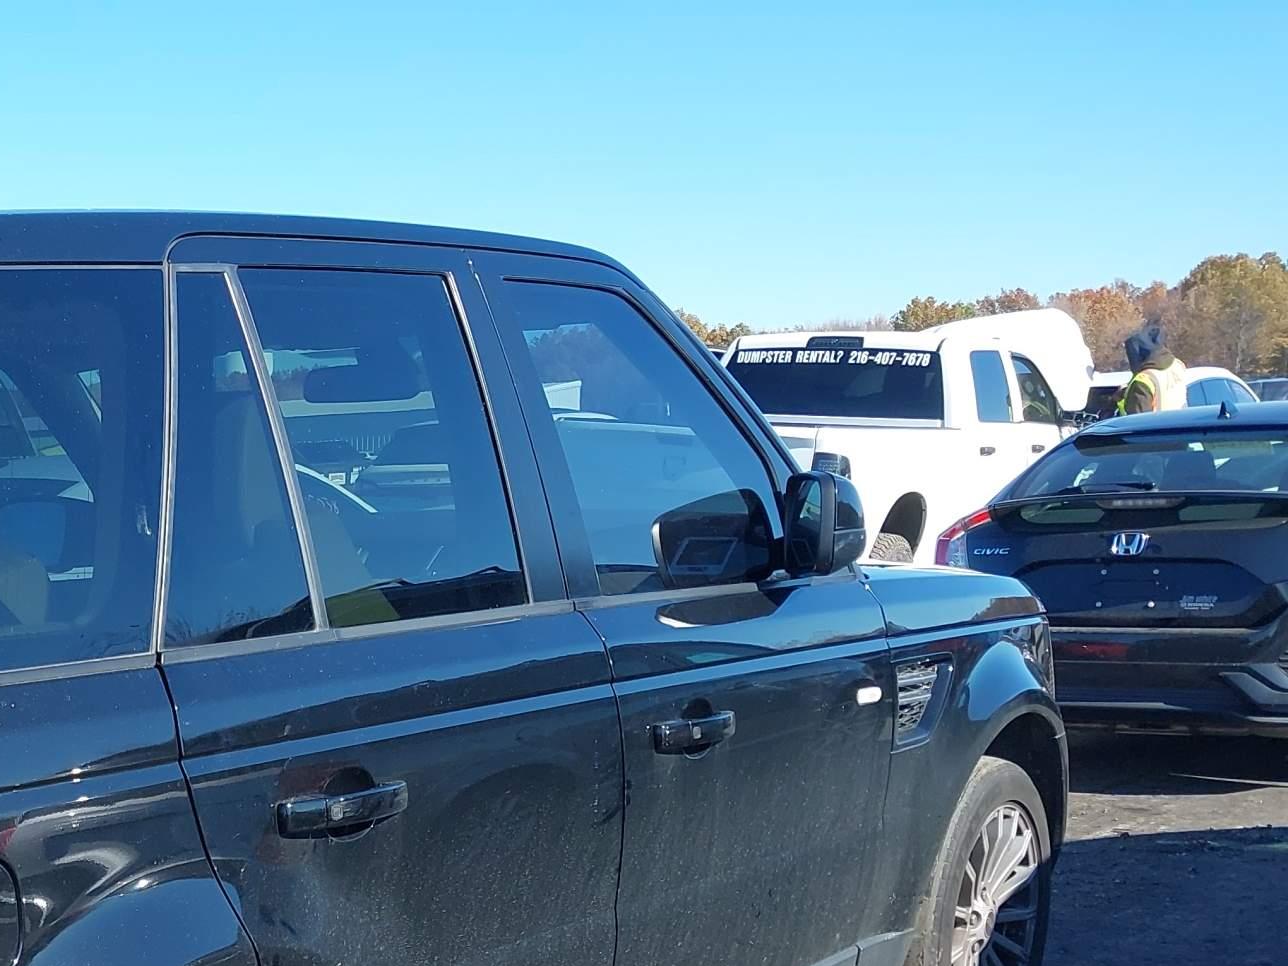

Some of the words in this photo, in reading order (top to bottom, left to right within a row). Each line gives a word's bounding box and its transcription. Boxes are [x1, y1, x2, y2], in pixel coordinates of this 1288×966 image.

[737, 350, 792, 363] DUMPSTER
[796, 351, 842, 363] RENTAL?
[974, 547, 1010, 555] CIVIC
